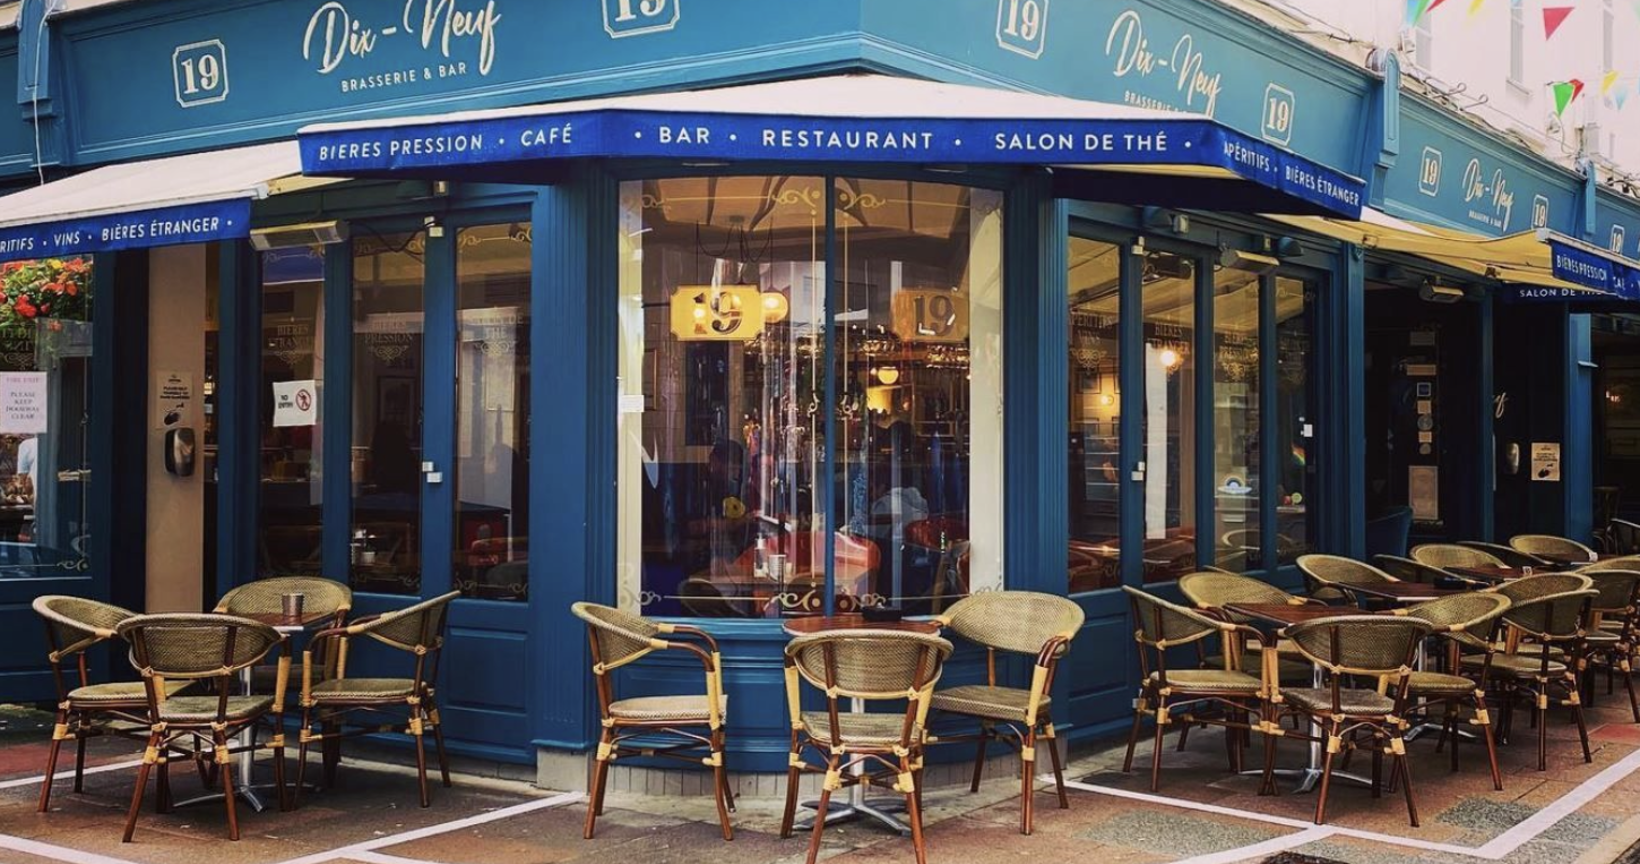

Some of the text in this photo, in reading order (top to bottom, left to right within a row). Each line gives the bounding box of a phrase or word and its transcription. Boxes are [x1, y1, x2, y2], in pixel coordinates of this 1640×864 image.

[303, 1, 377, 74] Dix
[403, 0, 502, 75] Neuf
[1004, 0, 1039, 41] 19
[181, 54, 219, 94] 19
[341, 61, 467, 92] BRASSERIE & BAR
[1105, 10, 1155, 77] Dix
[1171, 34, 1222, 119] Neuf
[1266, 98, 1289, 132] 19
[319, 123, 1167, 160] BIERES PRESSION CAFÉ BAR RESTAURANT SALON DE THÉ
[1223, 141, 1359, 207] APÉRITIFS BIÈRES ÉTRANGER
[1422, 158, 1438, 184] 19
[54, 231, 81, 247] VINS
[102, 223, 145, 241] BIÈRES
[150, 216, 220, 238] ÉTRANGER
[692, 291, 743, 335] 19
[1520, 289, 1557, 298] SALON
[914, 294, 955, 336] 19
